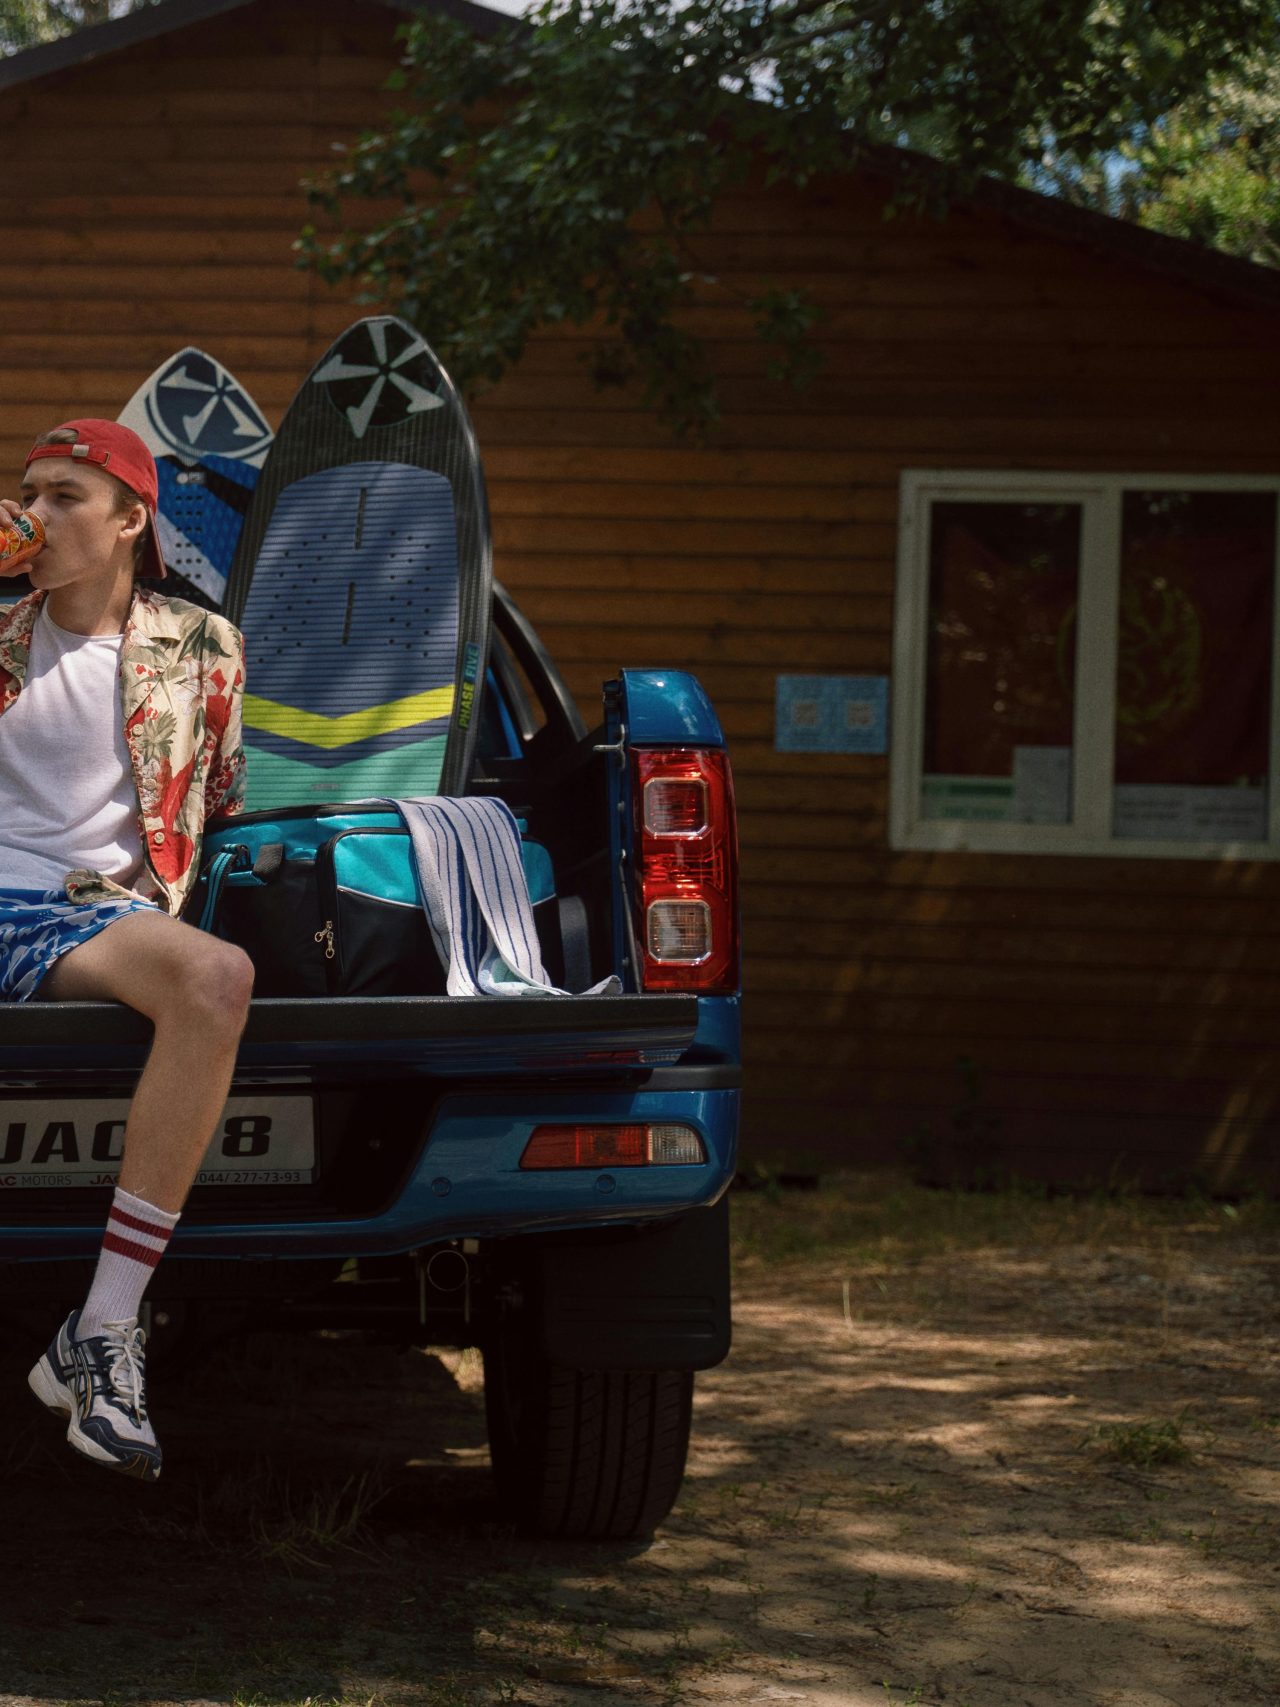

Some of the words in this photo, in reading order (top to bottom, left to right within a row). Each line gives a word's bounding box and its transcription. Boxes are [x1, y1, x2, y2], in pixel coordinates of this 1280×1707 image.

[12, 516, 35, 542] NDA
[464, 646, 478, 678] FIVE
[459, 681, 475, 729] PHASE
[21, 1174, 72, 1187] MOTORS
[233, 1171, 301, 1184] 277-73-93
